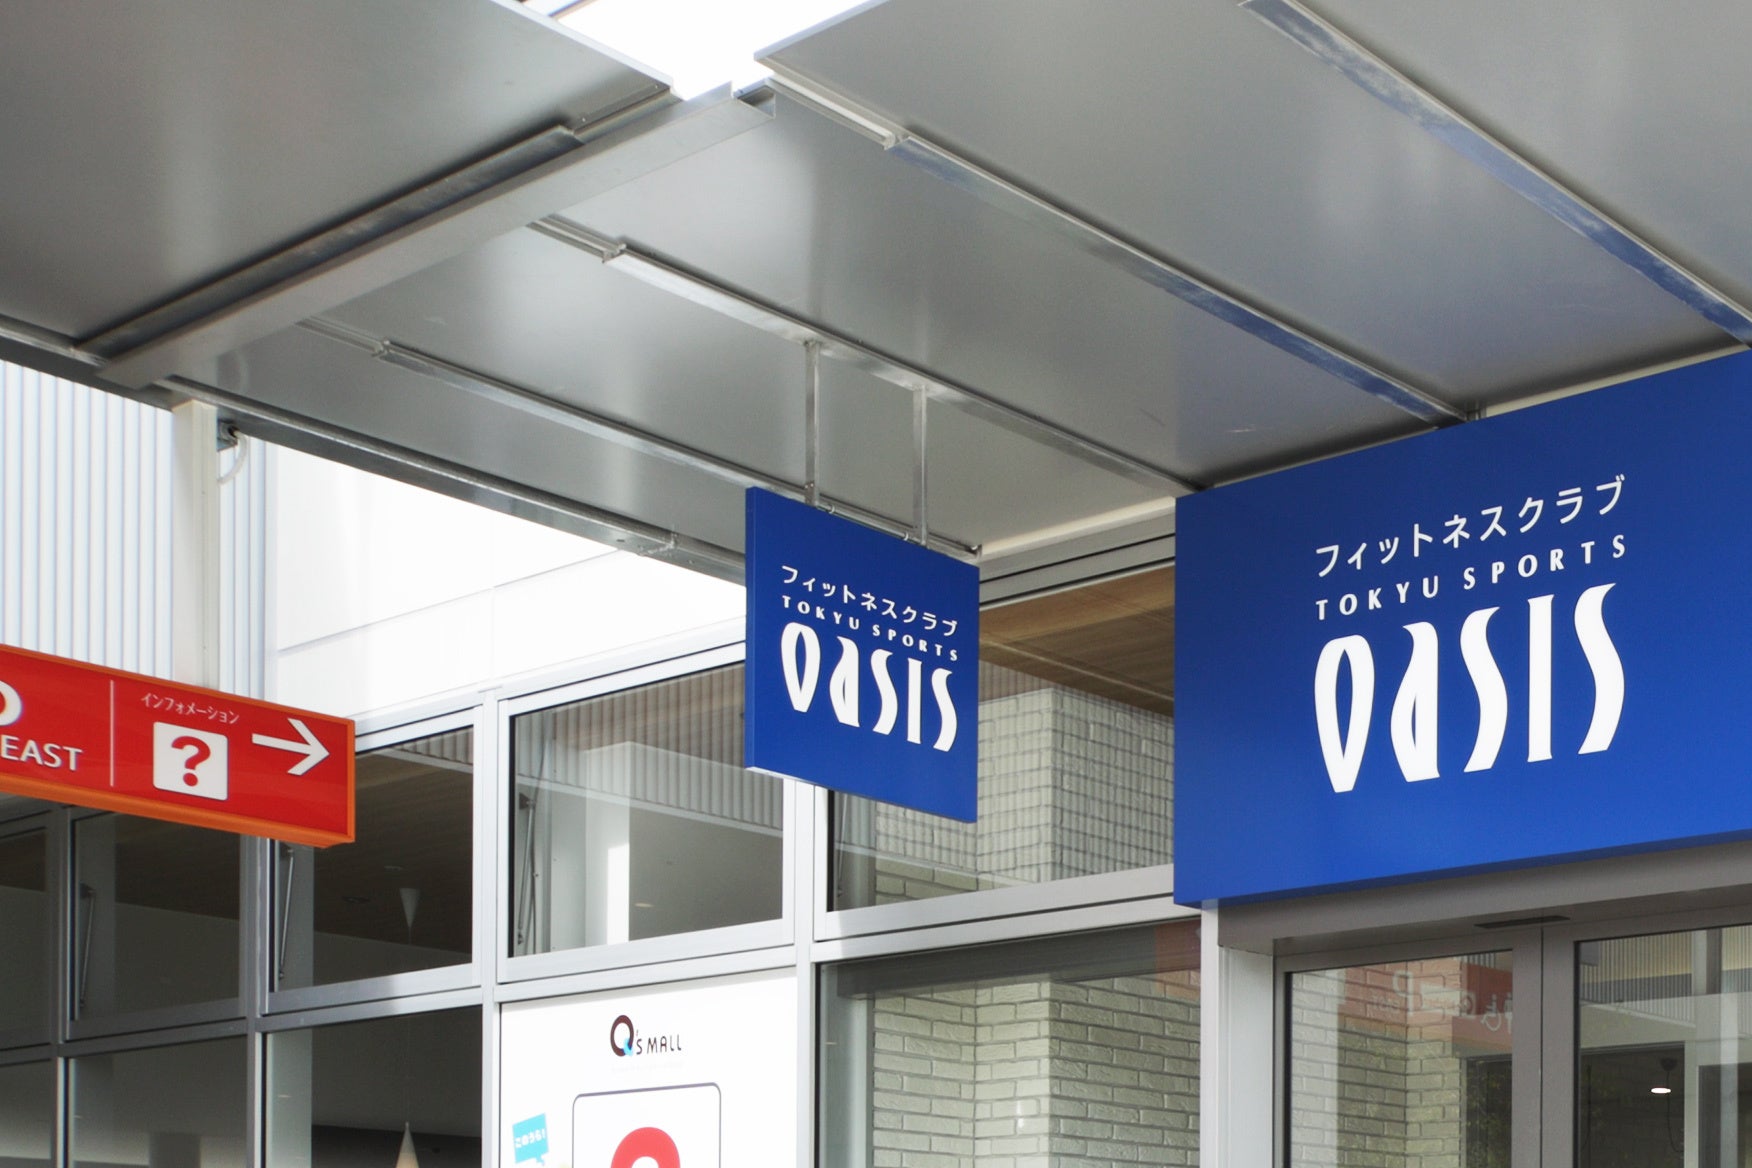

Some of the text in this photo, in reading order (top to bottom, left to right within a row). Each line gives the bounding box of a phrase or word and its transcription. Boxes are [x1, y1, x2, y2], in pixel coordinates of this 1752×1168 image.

[1316, 474, 1626, 577] フィットネスクラブ
[781, 565, 958, 637] フィットネスクラブ
[1316, 535, 1626, 621] TOKYU SPORTS
[782, 595, 958, 662] TOKYU SPORTS
[141, 692, 240, 725] インフォメーション
[0, 733, 83, 771] EAST
